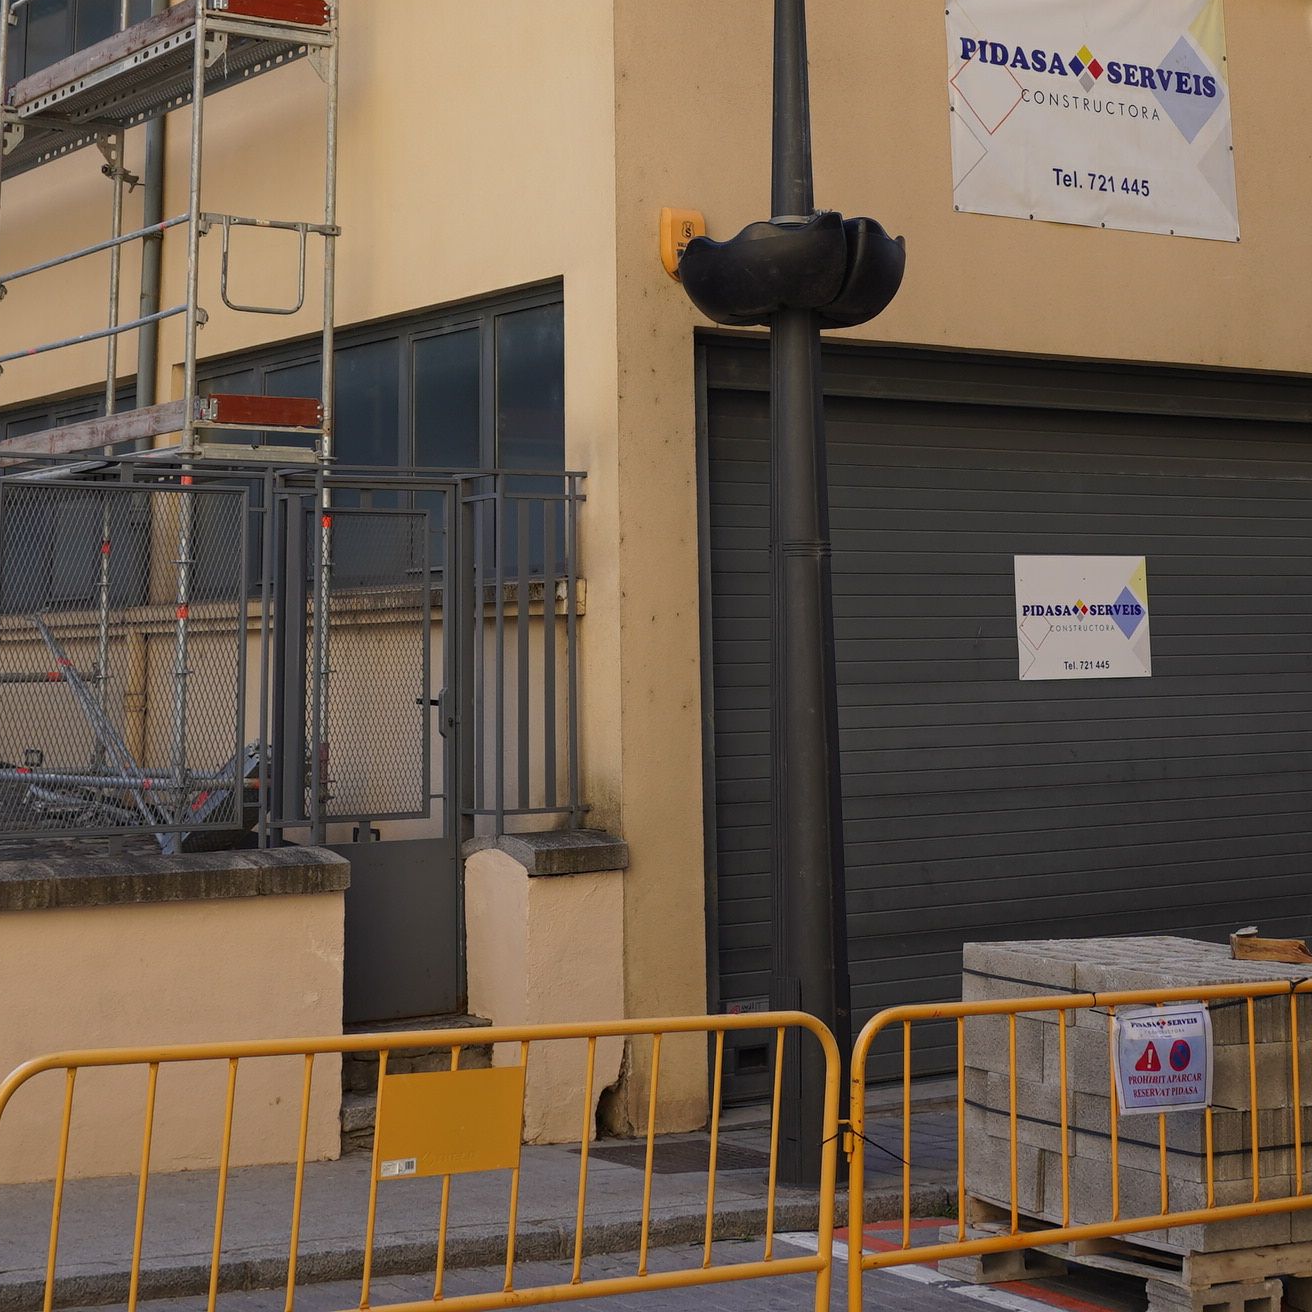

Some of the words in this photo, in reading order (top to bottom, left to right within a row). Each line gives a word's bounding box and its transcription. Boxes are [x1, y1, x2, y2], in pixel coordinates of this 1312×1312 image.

[960, 37, 1068, 76] PIDASA
[1107, 62, 1216, 98] SERVEIS
[1021, 89, 1160, 121] CONSTRUCTORA
[1052, 168, 1083, 189] Tel.
[1088, 172, 1115, 193] 721
[1121, 175, 1150, 197] 445
[1022, 605, 1072, 617] PIDASA
[1089, 604, 1142, 616] SERVEIS
[1050, 624, 1115, 632] CONSTRUCTORA
[1064, 661, 1078, 670] Tel.
[1079, 661, 1093, 670] 721
[1095, 660, 1110, 669] 445
[1167, 1018, 1198, 1026] SERVEIS
[1128, 1074, 1165, 1085] PROHIBIT
[1167, 1073, 1202, 1083] APARCAR
[1133, 1088, 1171, 1098] RESERVAT
[1171, 1086, 1198, 1096] PIDASA
